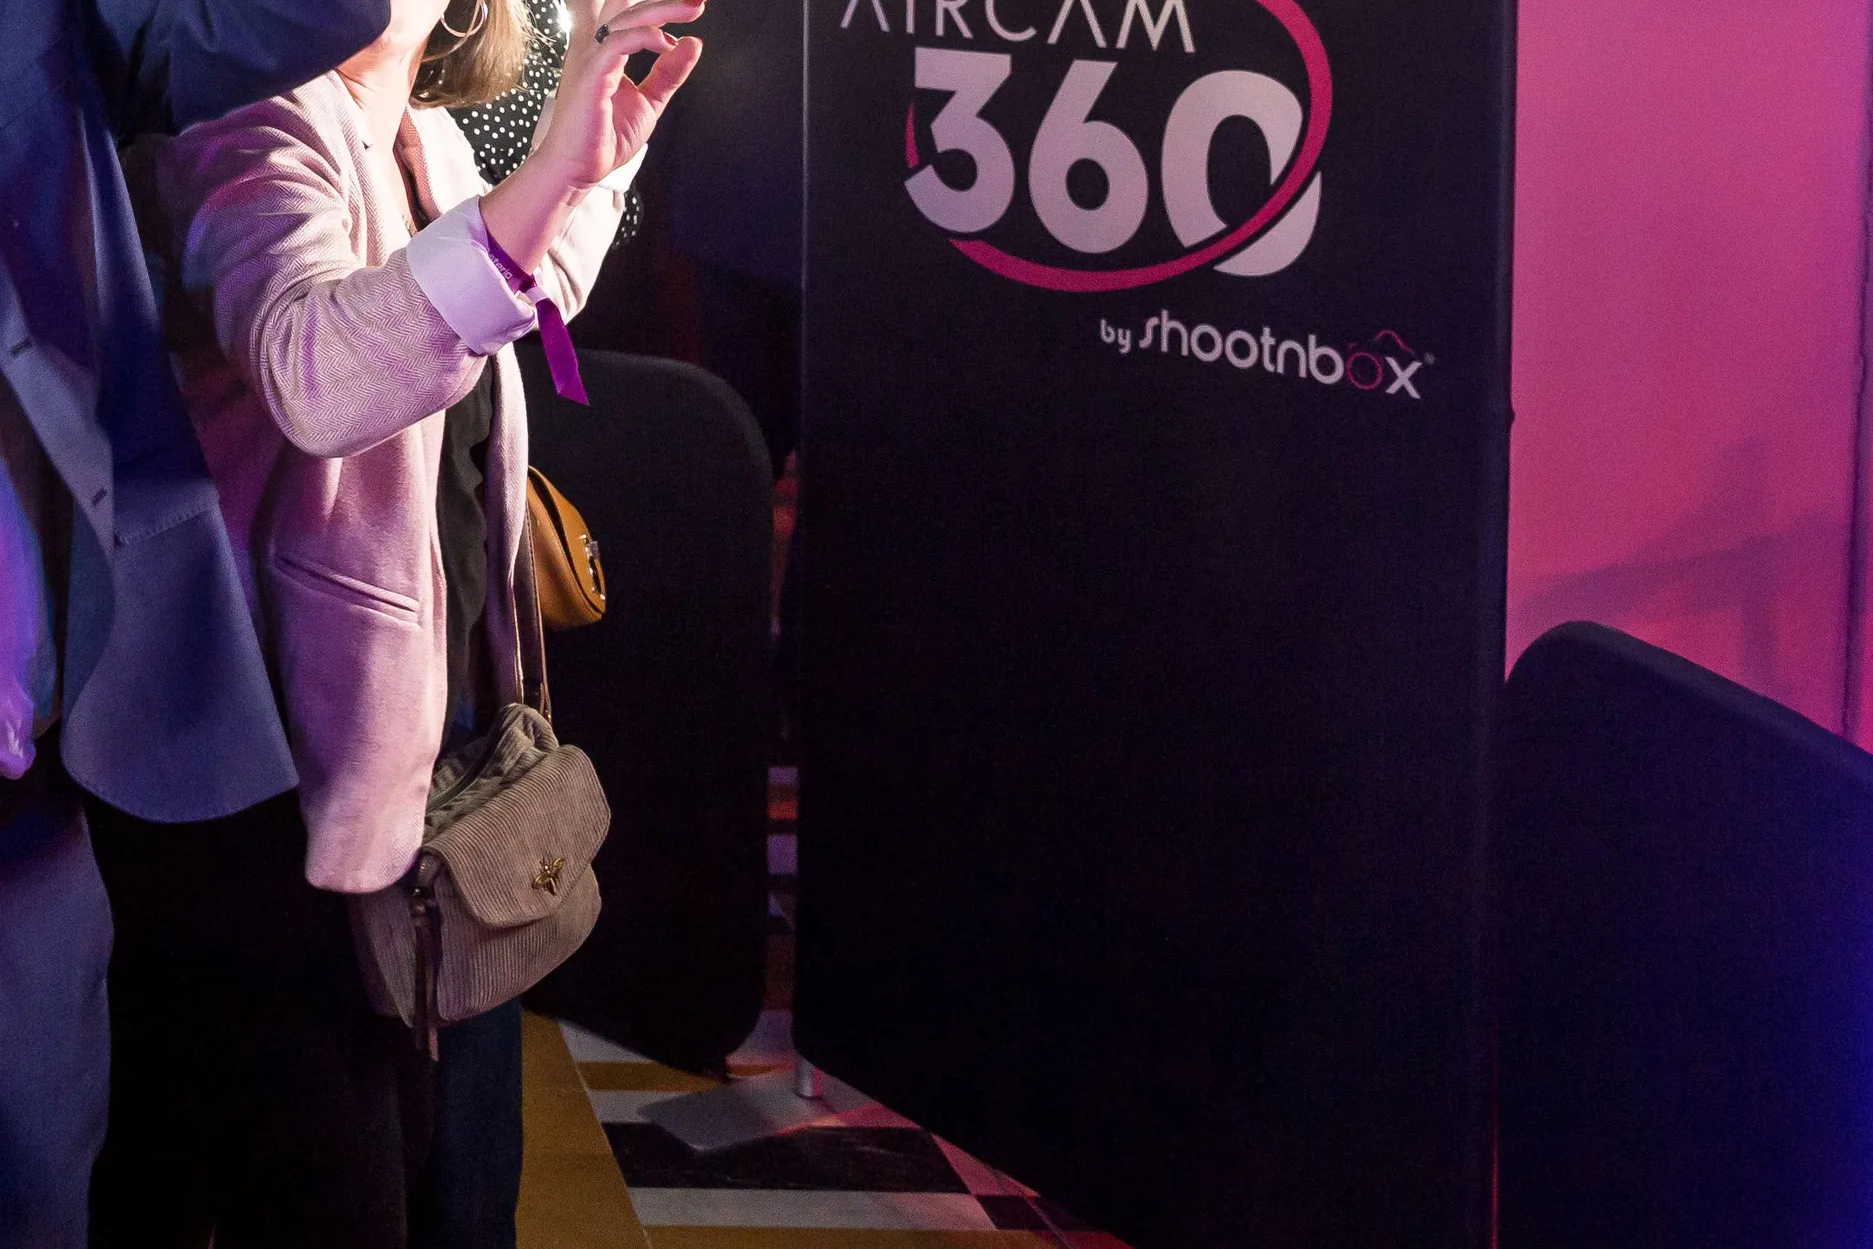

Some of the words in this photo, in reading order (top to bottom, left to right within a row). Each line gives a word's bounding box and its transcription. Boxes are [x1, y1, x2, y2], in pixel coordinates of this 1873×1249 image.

[904, 47, 1322, 276] 360
[1100, 319, 1131, 353] by
[1139, 309, 1423, 399] shootnbox
